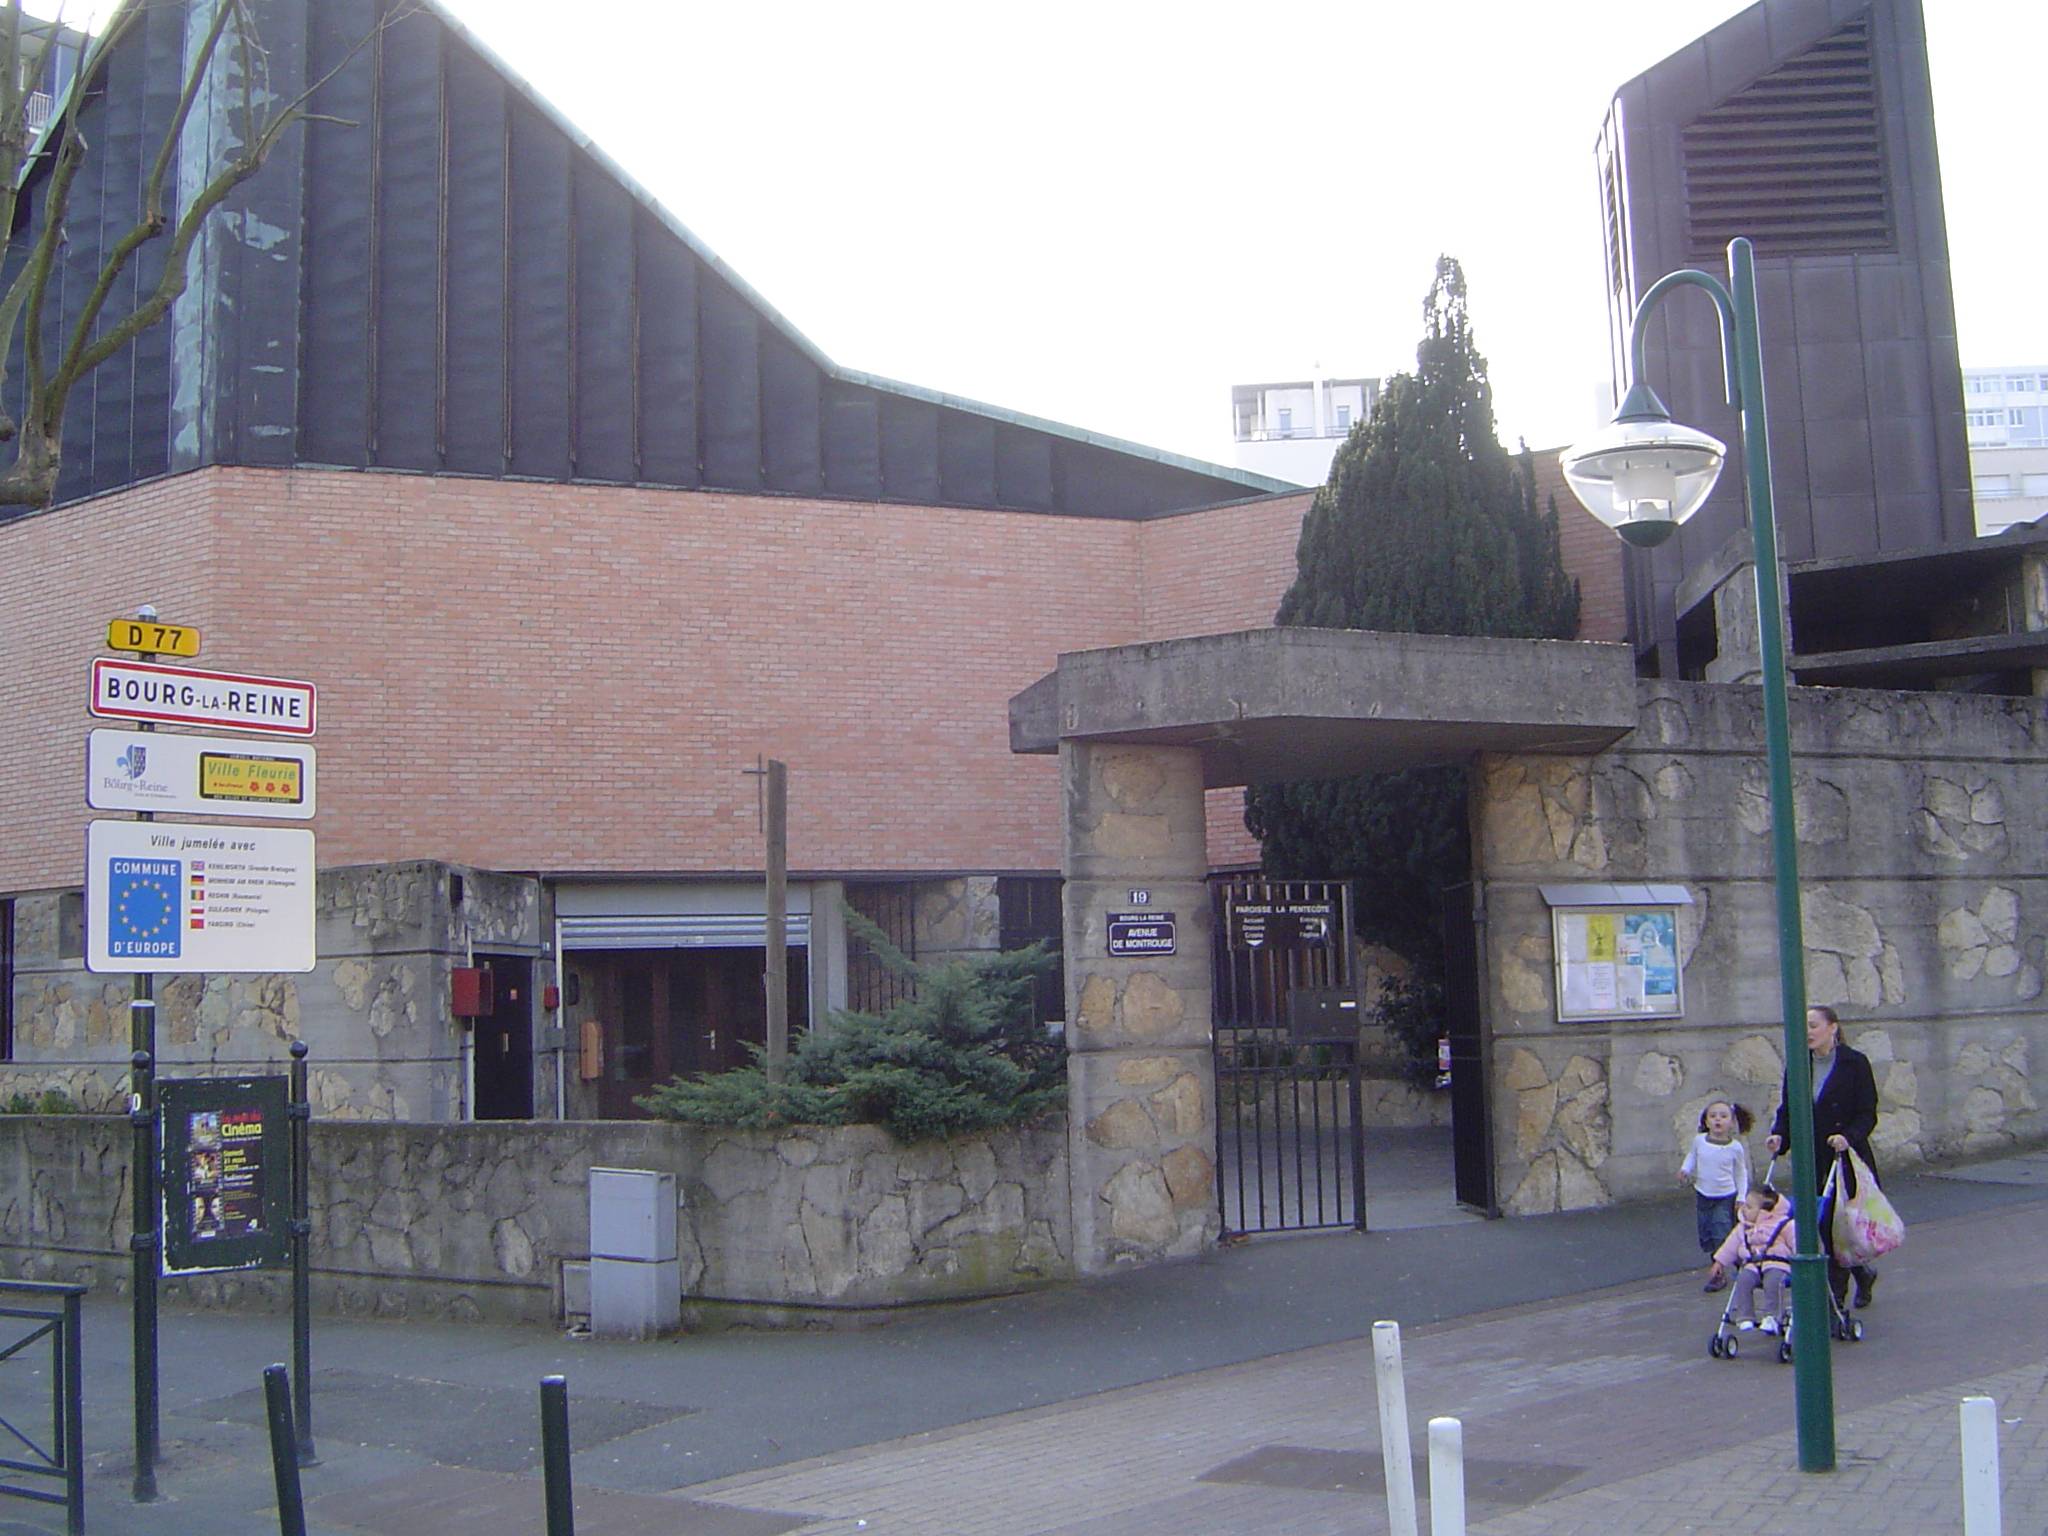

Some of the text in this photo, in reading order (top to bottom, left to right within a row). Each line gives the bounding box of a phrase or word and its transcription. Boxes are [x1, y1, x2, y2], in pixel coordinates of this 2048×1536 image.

[129, 626, 182, 650] D 77
[107, 677, 301, 718] BOURG-LA-REINE
[207, 762, 296, 781] Ville Fleurie
[151, 834, 256, 851] Ville jumelée avec
[114, 862, 177, 876] COMMUNE
[1133, 892, 1147, 904] 19
[1235, 905, 1272, 913] PAROISSE
[1128, 928, 1157, 937] AVENUE
[114, 941, 175, 955] D'EUROPE
[1113, 938, 1173, 949] DE MONTROUGE
[221, 1122, 262, 1136] Cinéma
